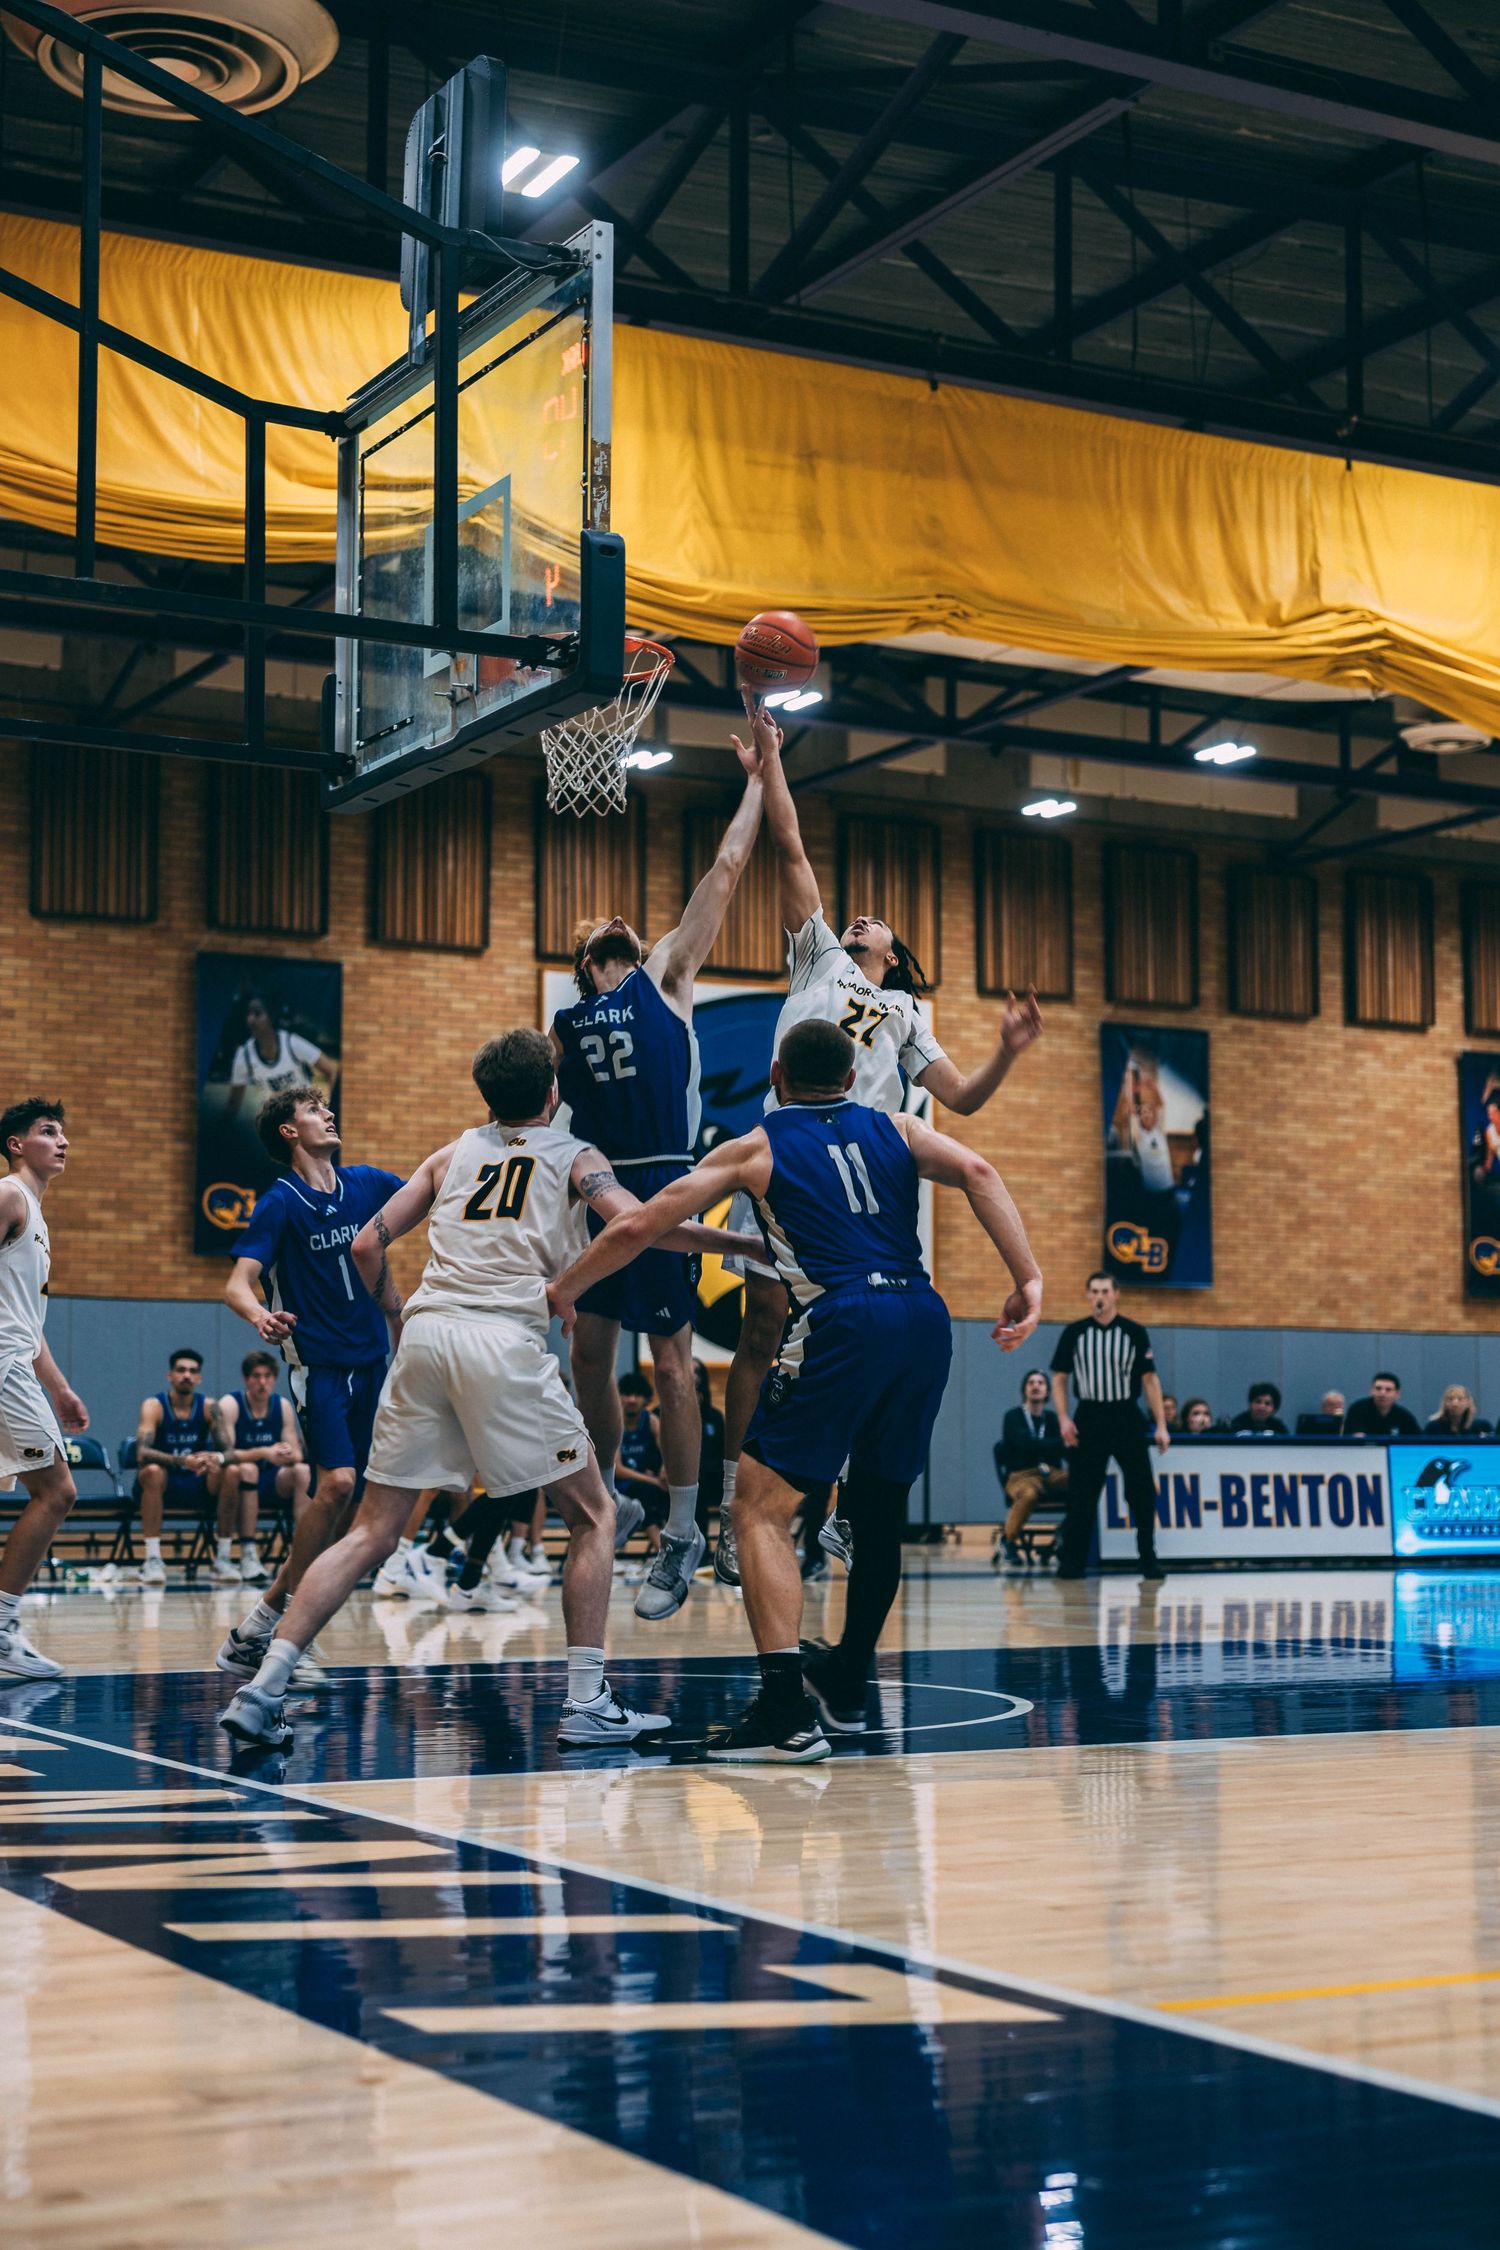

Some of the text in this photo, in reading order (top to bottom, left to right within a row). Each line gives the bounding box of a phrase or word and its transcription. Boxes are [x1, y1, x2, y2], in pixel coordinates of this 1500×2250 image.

[572, 1005, 635, 1029] CLARK
[580, 1030, 637, 1082] 22
[462, 1155, 537, 1222] 20
[826, 1142, 880, 1215] 11
[309, 1224, 359, 1251] CLARK
[338, 1254, 355, 1301] 1
[1104, 1472, 1386, 1530] LNN-BENTON
